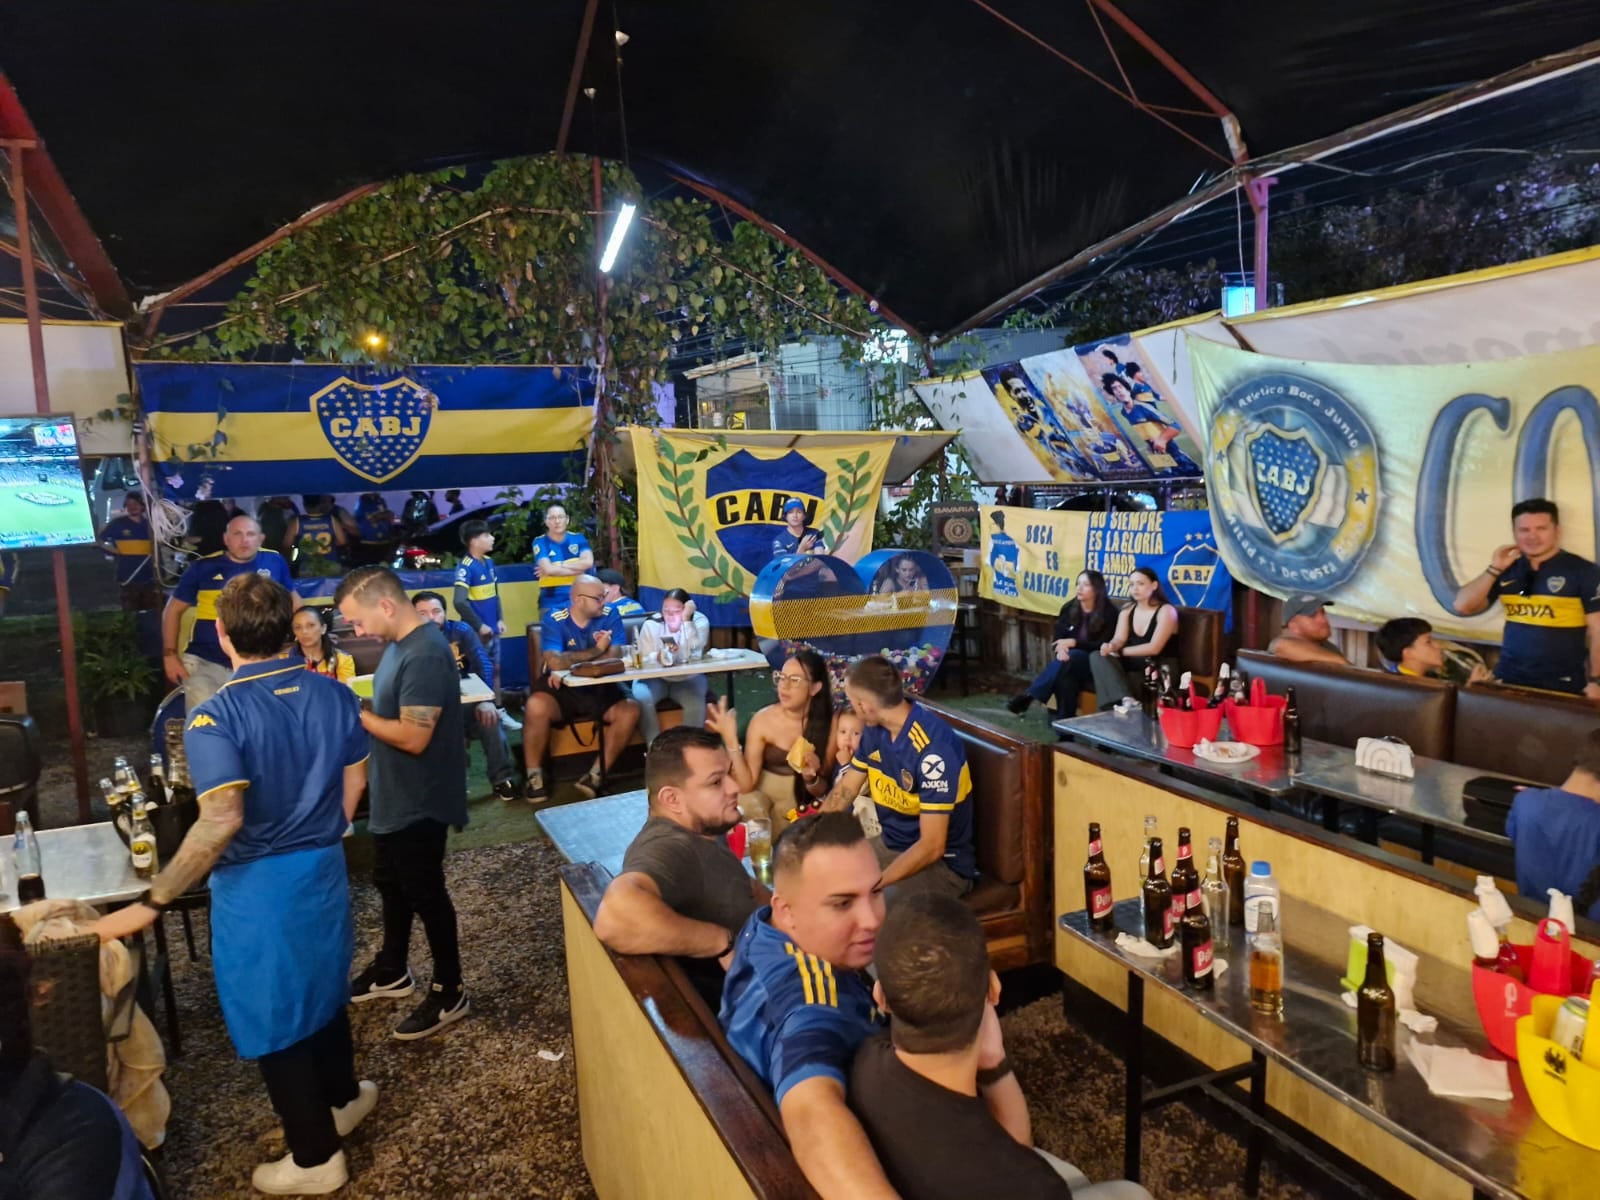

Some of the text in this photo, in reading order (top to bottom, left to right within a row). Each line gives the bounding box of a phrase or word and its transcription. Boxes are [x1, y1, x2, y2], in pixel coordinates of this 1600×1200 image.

[1288, 385, 1321, 408] Boca
[330, 416, 421, 438] CABJ
[1256, 461, 1312, 495] CABJ
[934, 506, 975, 514] BAVARIA
[1109, 511, 1164, 532] SIEMPRE
[1026, 524, 1053, 545] BOCA
[1089, 531, 1164, 554] ES LA GLORIA
[1046, 550, 1059, 571] ES
[1087, 552, 1136, 574] EL AMOR
[1171, 568, 1211, 583] CABJ
[1301, 562, 1338, 581] Costa
[1023, 571, 1070, 598] CARTAGO
[921, 780, 949, 789] AXION
